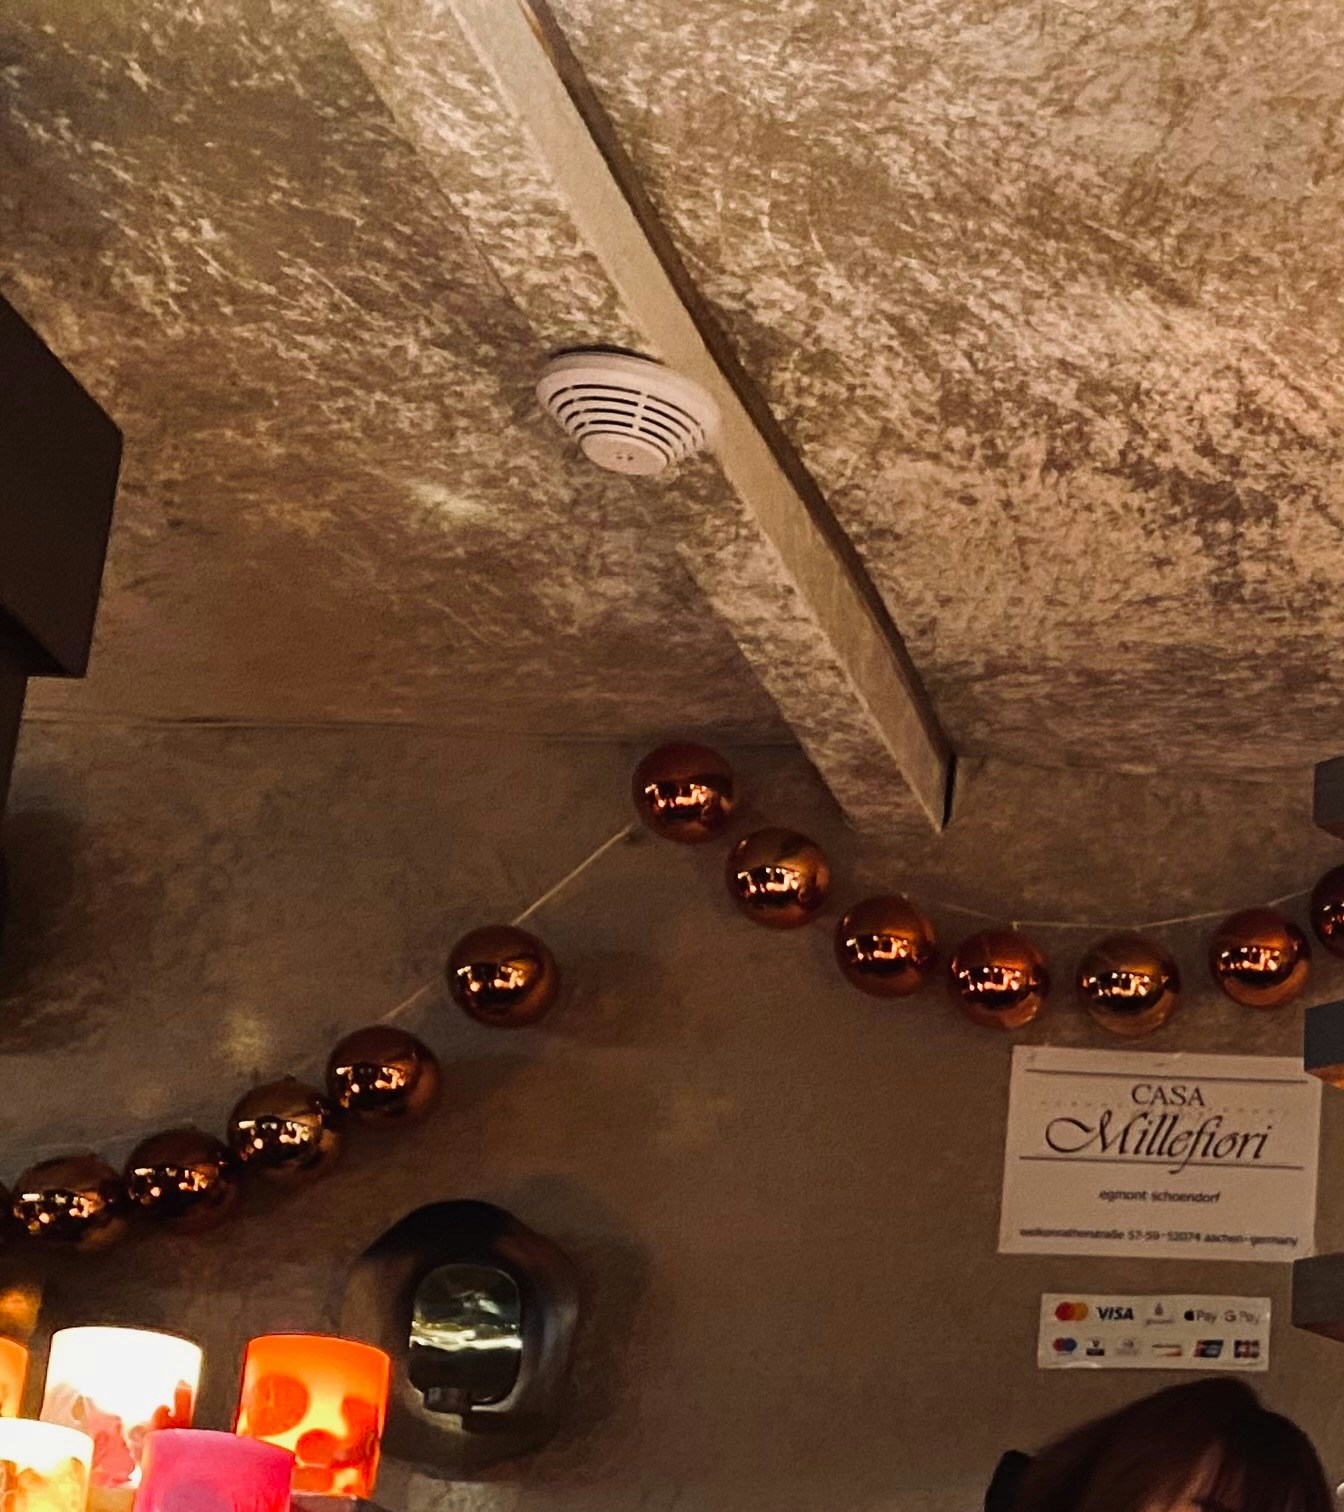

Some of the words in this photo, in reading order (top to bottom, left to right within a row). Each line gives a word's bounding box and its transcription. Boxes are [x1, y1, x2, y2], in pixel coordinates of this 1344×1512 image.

[1131, 1084, 1205, 1107] CASA
[1045, 1109, 1272, 1174] Millefiori
[1096, 1306, 1135, 1321] VISA
